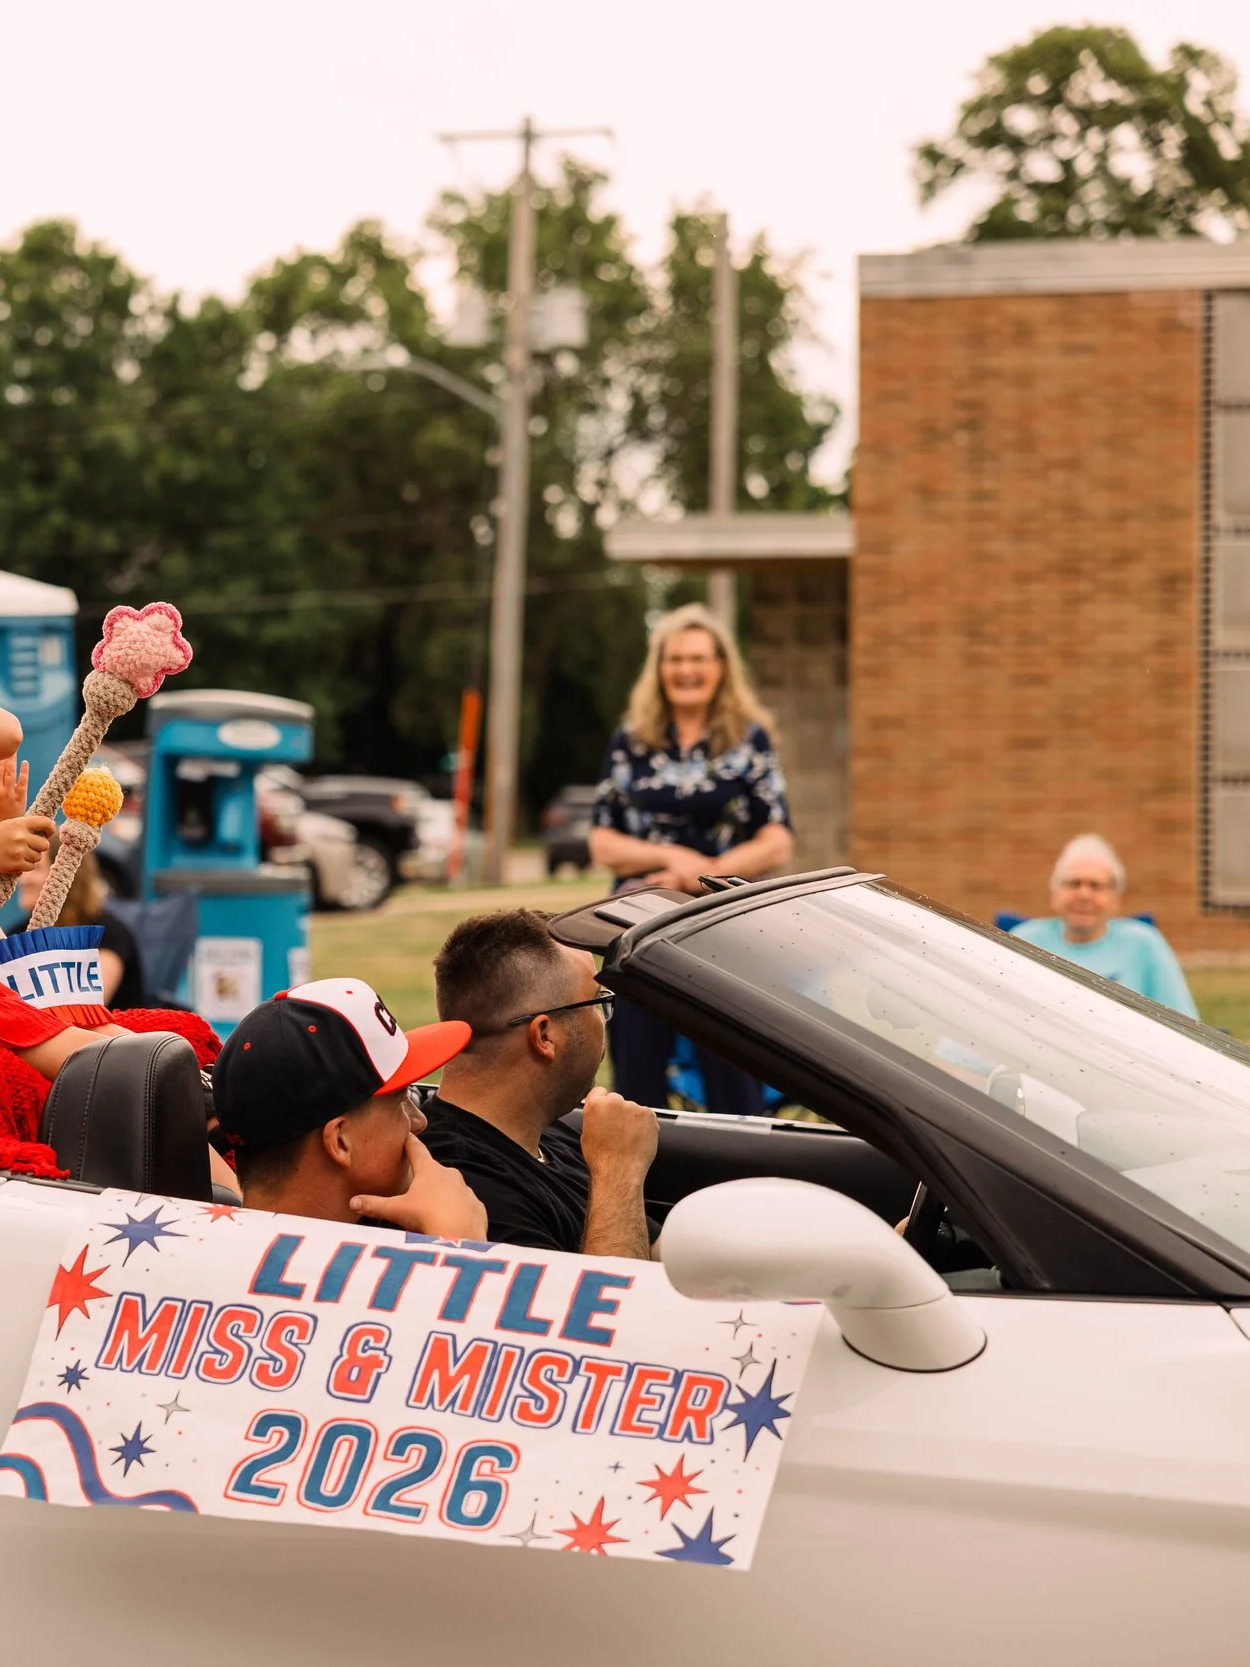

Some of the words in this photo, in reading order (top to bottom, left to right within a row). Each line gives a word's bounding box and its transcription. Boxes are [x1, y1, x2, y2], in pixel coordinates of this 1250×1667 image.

[7, 962, 103, 1001] LITTLE
[248, 1233, 635, 1347] LITTLE
[95, 1291, 318, 1392] MISS
[327, 1322, 392, 1403] &
[406, 1331, 732, 1444] MISTER
[223, 1408, 520, 1531] 2026
